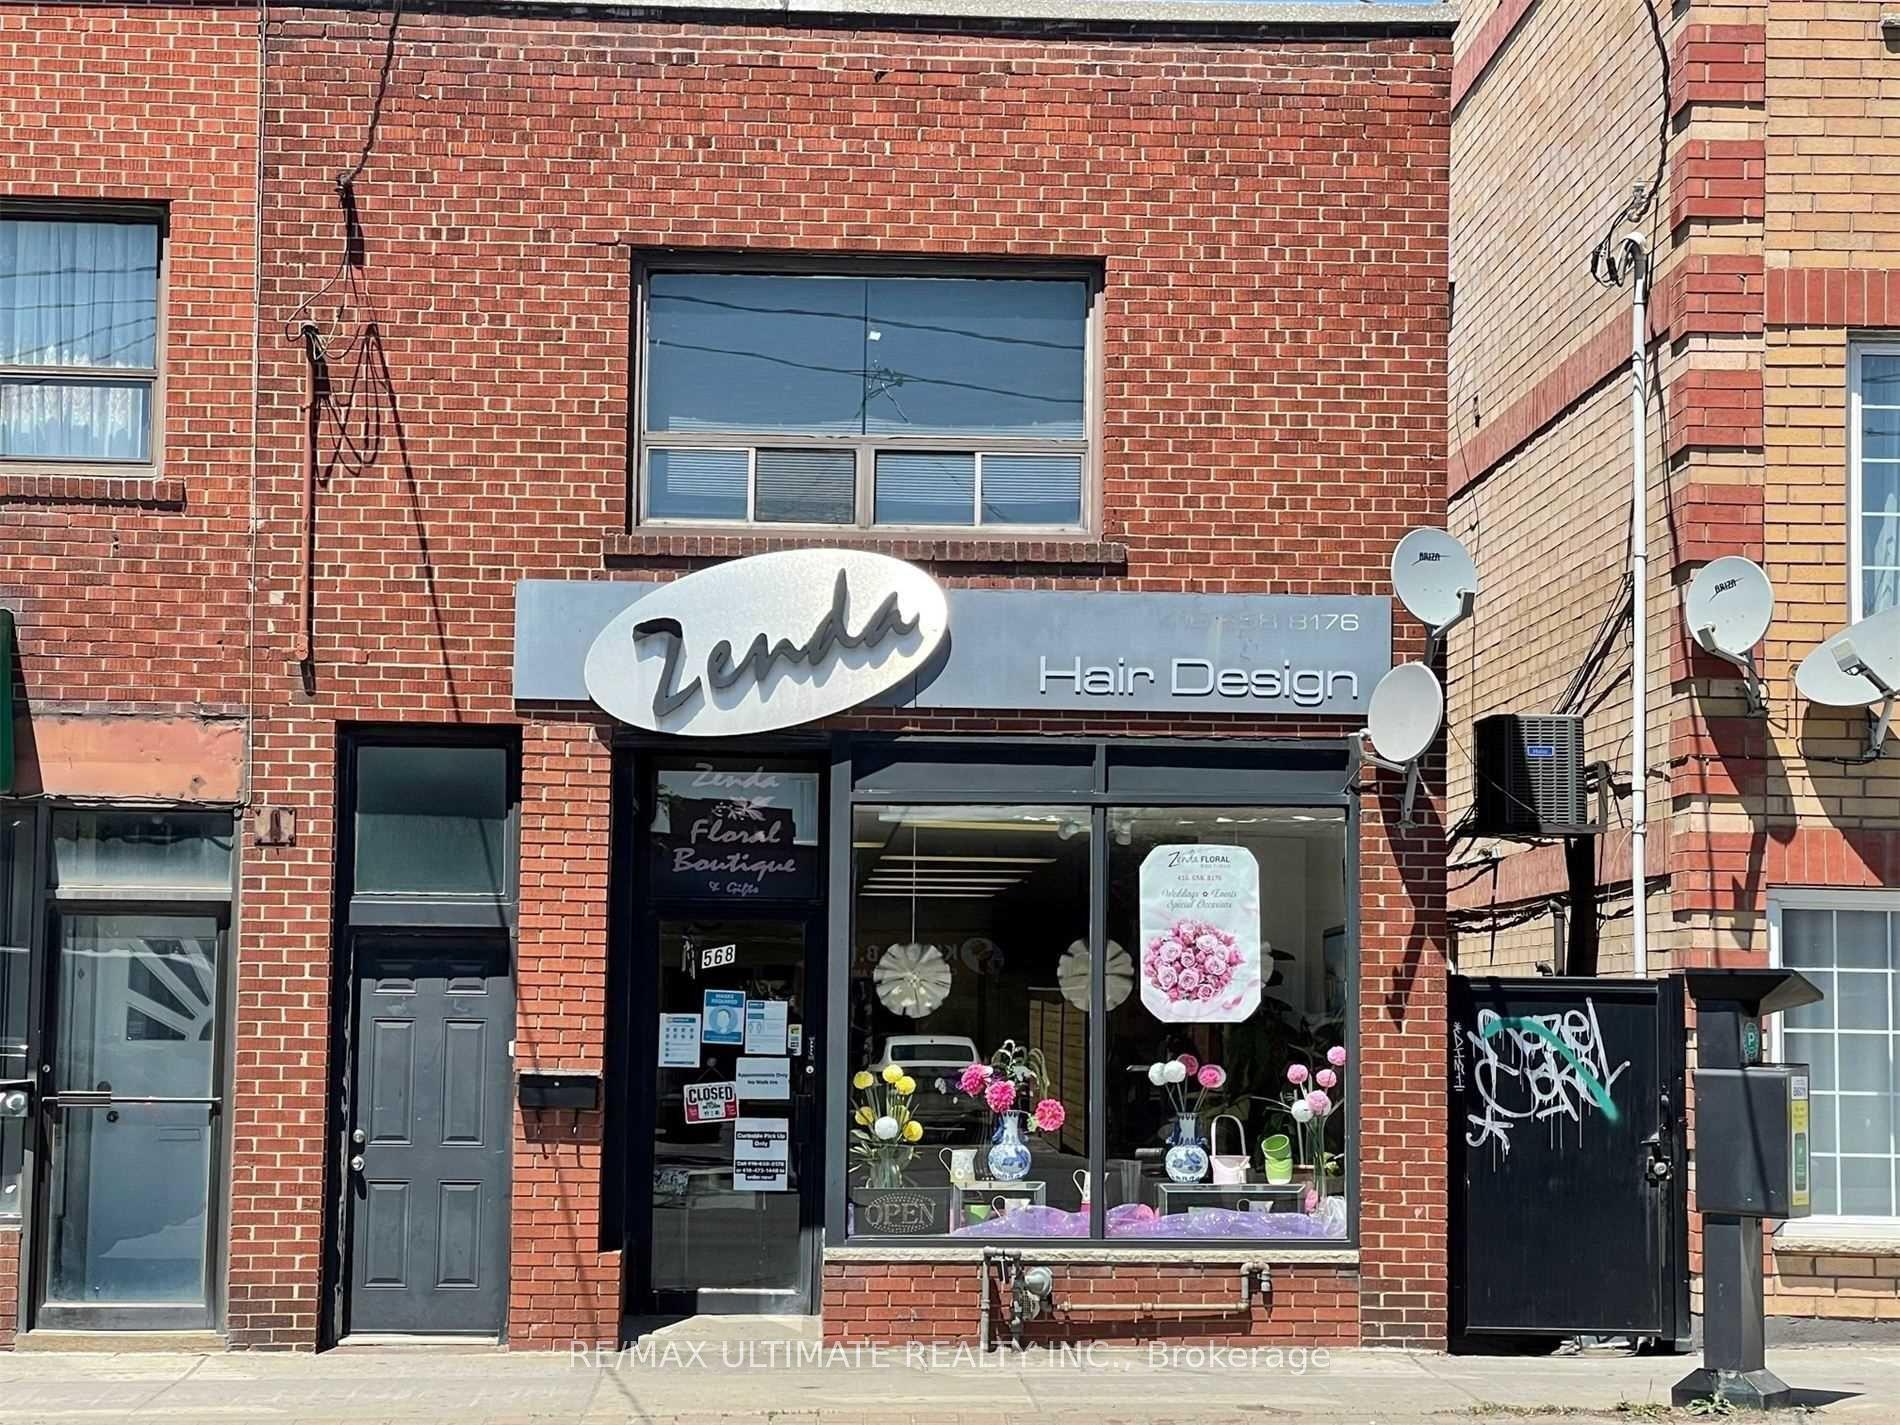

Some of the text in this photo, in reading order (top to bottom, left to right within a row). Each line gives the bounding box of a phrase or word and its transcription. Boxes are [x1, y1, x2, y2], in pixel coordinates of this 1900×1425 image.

[632, 567, 921, 718] Zenda
[1039, 655, 1360, 706] Hair Design
[691, 762, 781, 789] Zenda
[690, 819, 781, 845] Floral
[672, 847, 797, 882] Boutique
[1200, 855, 1232, 863] FLORAL
[726, 881, 760, 897] Gifts
[703, 946, 735, 967] 568
[688, 1086, 733, 1104] CLOSED
[864, 1201, 937, 1226] OPEN
